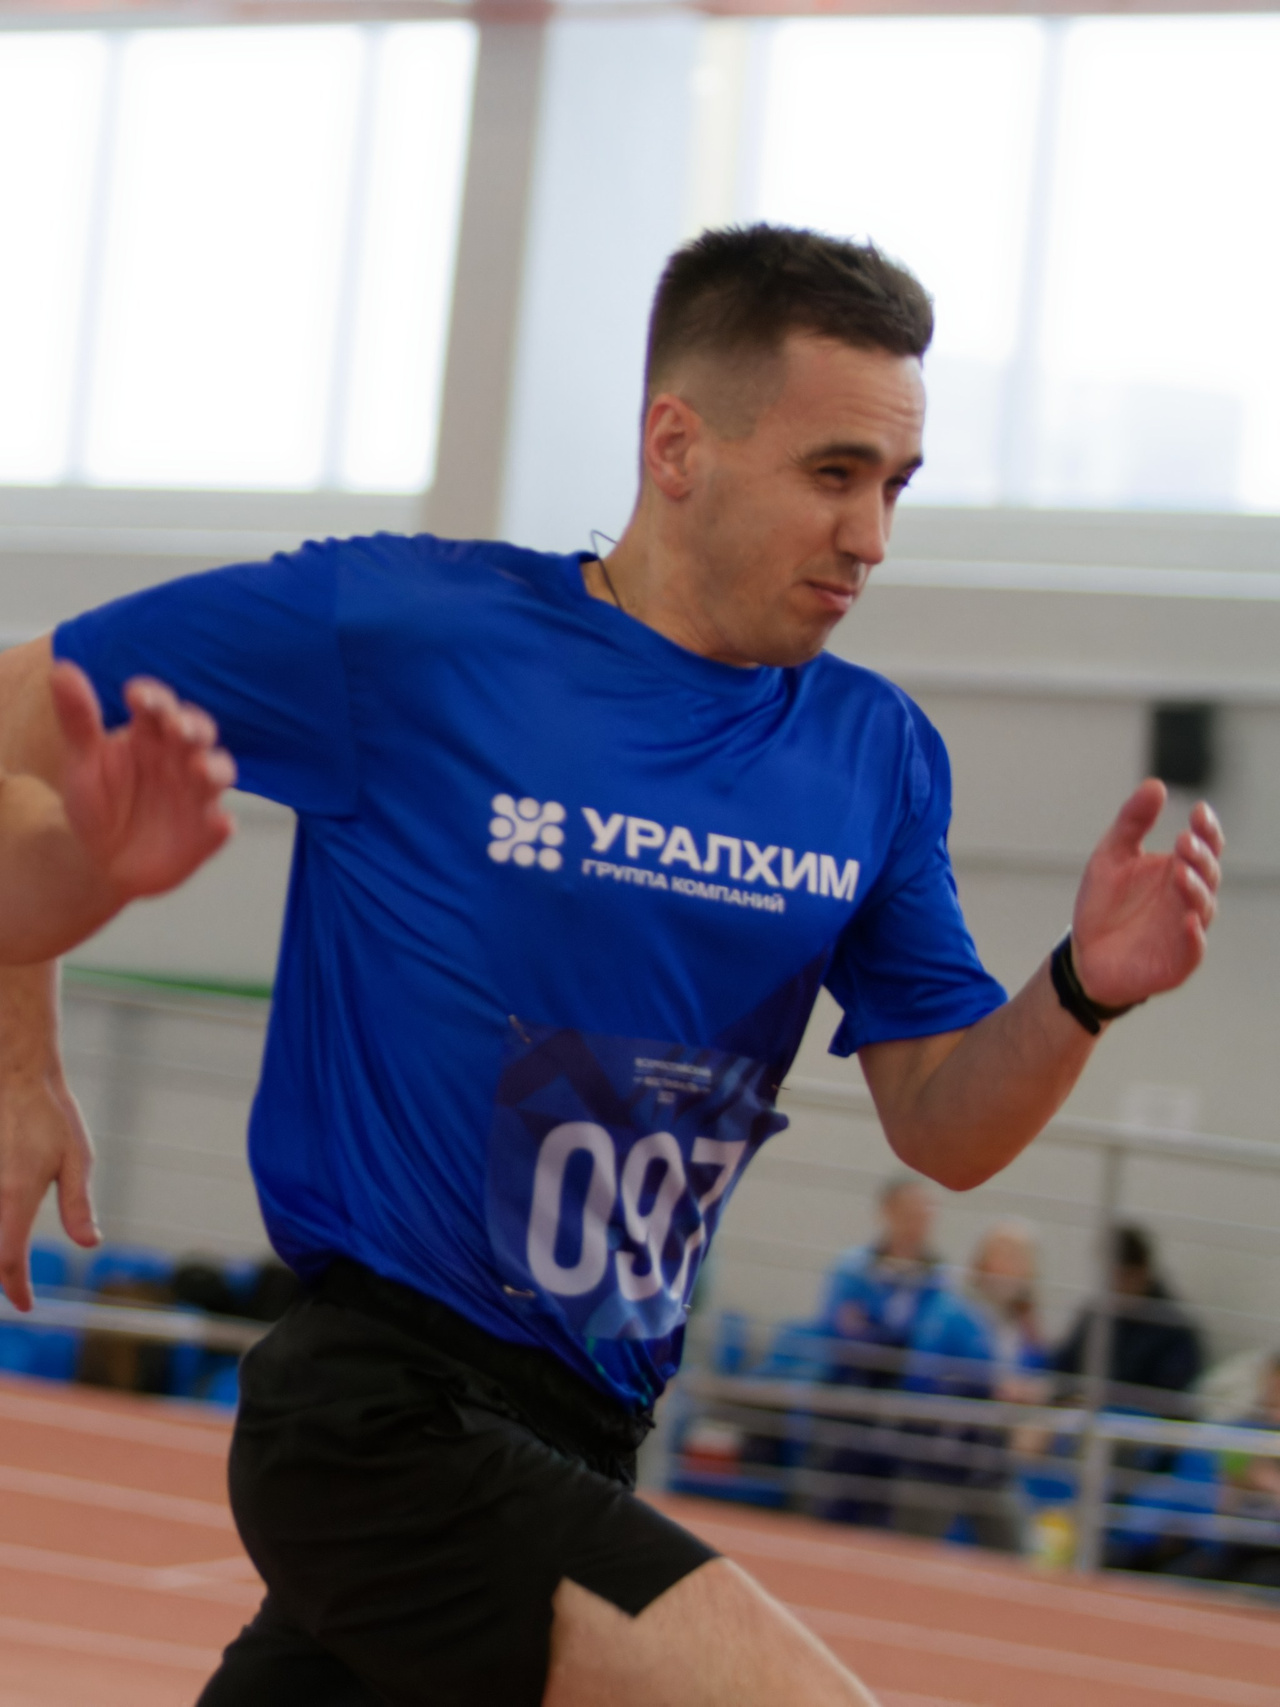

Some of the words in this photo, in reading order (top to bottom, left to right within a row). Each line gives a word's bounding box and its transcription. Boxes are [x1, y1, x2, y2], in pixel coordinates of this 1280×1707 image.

[581, 806, 860, 902] УРАЛХИМ
[581, 858, 669, 890] ГРУППА
[670, 876, 786, 914] КОМПАНИЙ
[527, 1120, 748, 1301] 097
